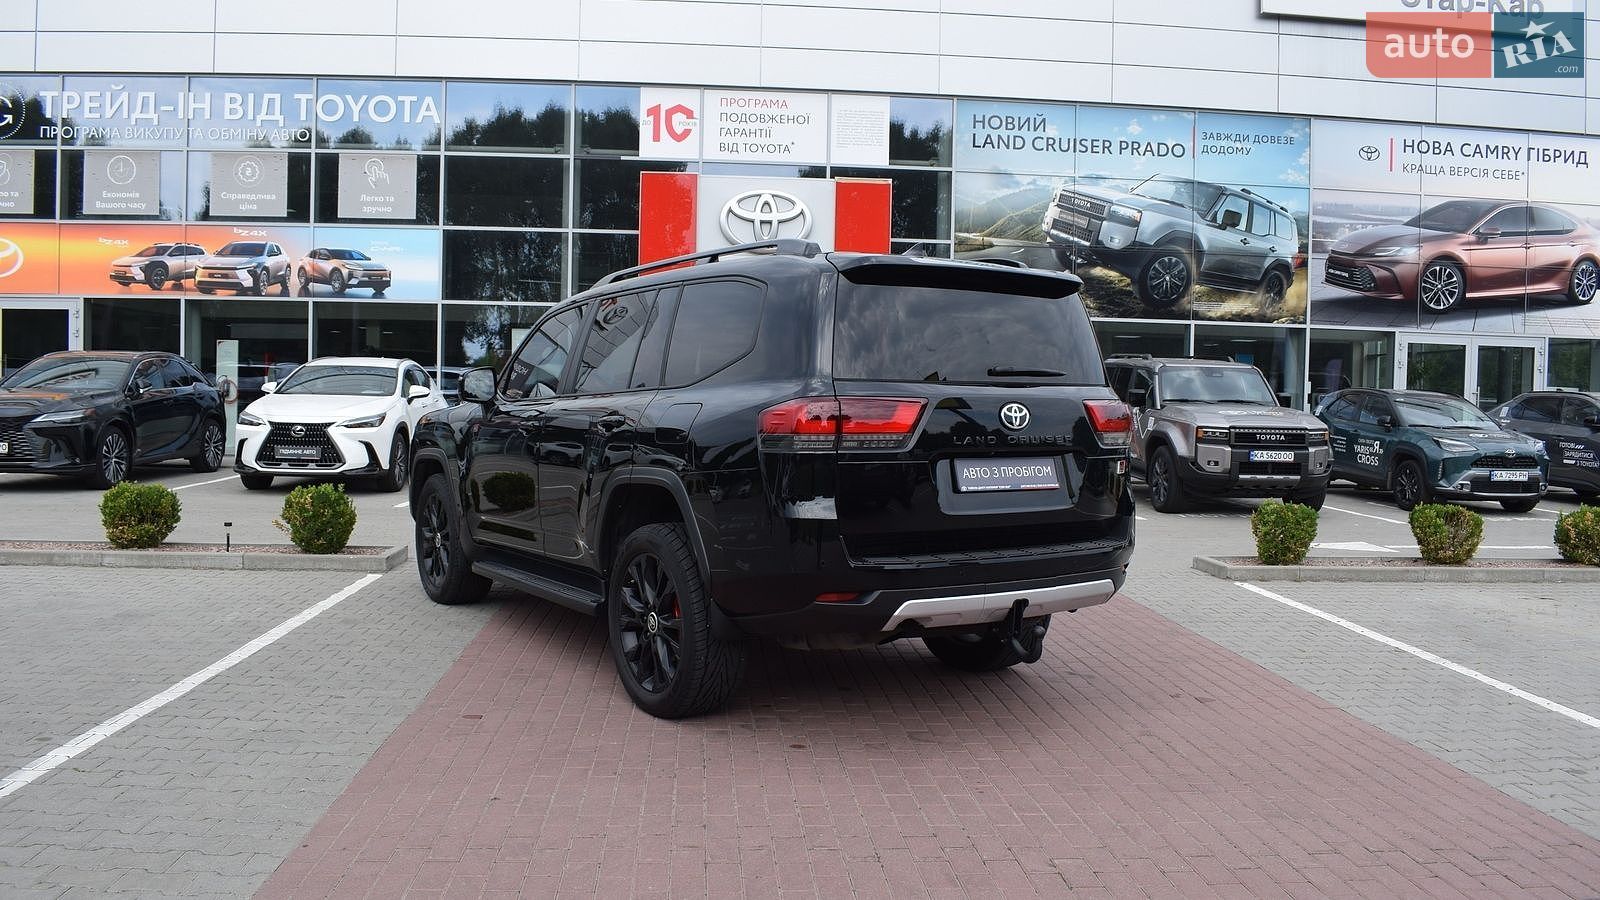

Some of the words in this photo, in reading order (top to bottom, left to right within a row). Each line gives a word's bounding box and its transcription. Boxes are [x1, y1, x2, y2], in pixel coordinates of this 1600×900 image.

[39, 84, 211, 126] ТРЕЙД-ІН
[223, 92, 284, 127] ВІД
[293, 93, 441, 124] TOYOTA
[720, 97, 788, 109] ПРОГРАМА
[719, 112, 811, 125] ПОДОВЖЕНОЇ
[972, 113, 1047, 133] НОВИЙ
[40, 126, 121, 139] ПРОГРАМА
[125, 126, 184, 140] ВИКУПУ
[187, 127, 204, 140] ТА
[208, 128, 267, 141] ОБМІНУ
[270, 128, 310, 141] АВТО
[719, 127, 772, 139] ГАРАНТІЇ
[1201, 131, 1250, 145] ЗАВЖДИ
[1253, 133, 1295, 146] ДОВЕЗЕ
[719, 142, 739, 154] ВІД
[971, 133, 1026, 151] LAND
[1032, 136, 1113, 155] CRUISER
[1119, 140, 1186, 158] PRADO
[1201, 145, 1252, 156] ДОДОМУ
[1403, 138, 1455, 157] НОВА
[1460, 142, 1522, 161] CAMRY
[1527, 147, 1590, 169] ГІБРИД
[1402, 163, 1446, 177] КРАЩА
[1449, 166, 1489, 179] ВЕРСІЯ
[102, 190, 140, 198] Економія
[221, 191, 276, 200] Справедлива
[360, 194, 384, 202] Легко
[95, 201, 126, 209] Вашого
[127, 201, 146, 209] часу
[239, 202, 257, 210] ціна
[1071, 198, 1091, 207] TOYOTA
[362, 205, 392, 213] зручно
[953, 435, 997, 445] LAND
[1007, 434, 1074, 445] CRUISER
[1265, 451, 1282, 460] 5620
[1357, 453, 1379, 466] CROSS
[963, 467, 991, 478] АВТО
[1001, 465, 1052, 477] ПРОБІГОМ
